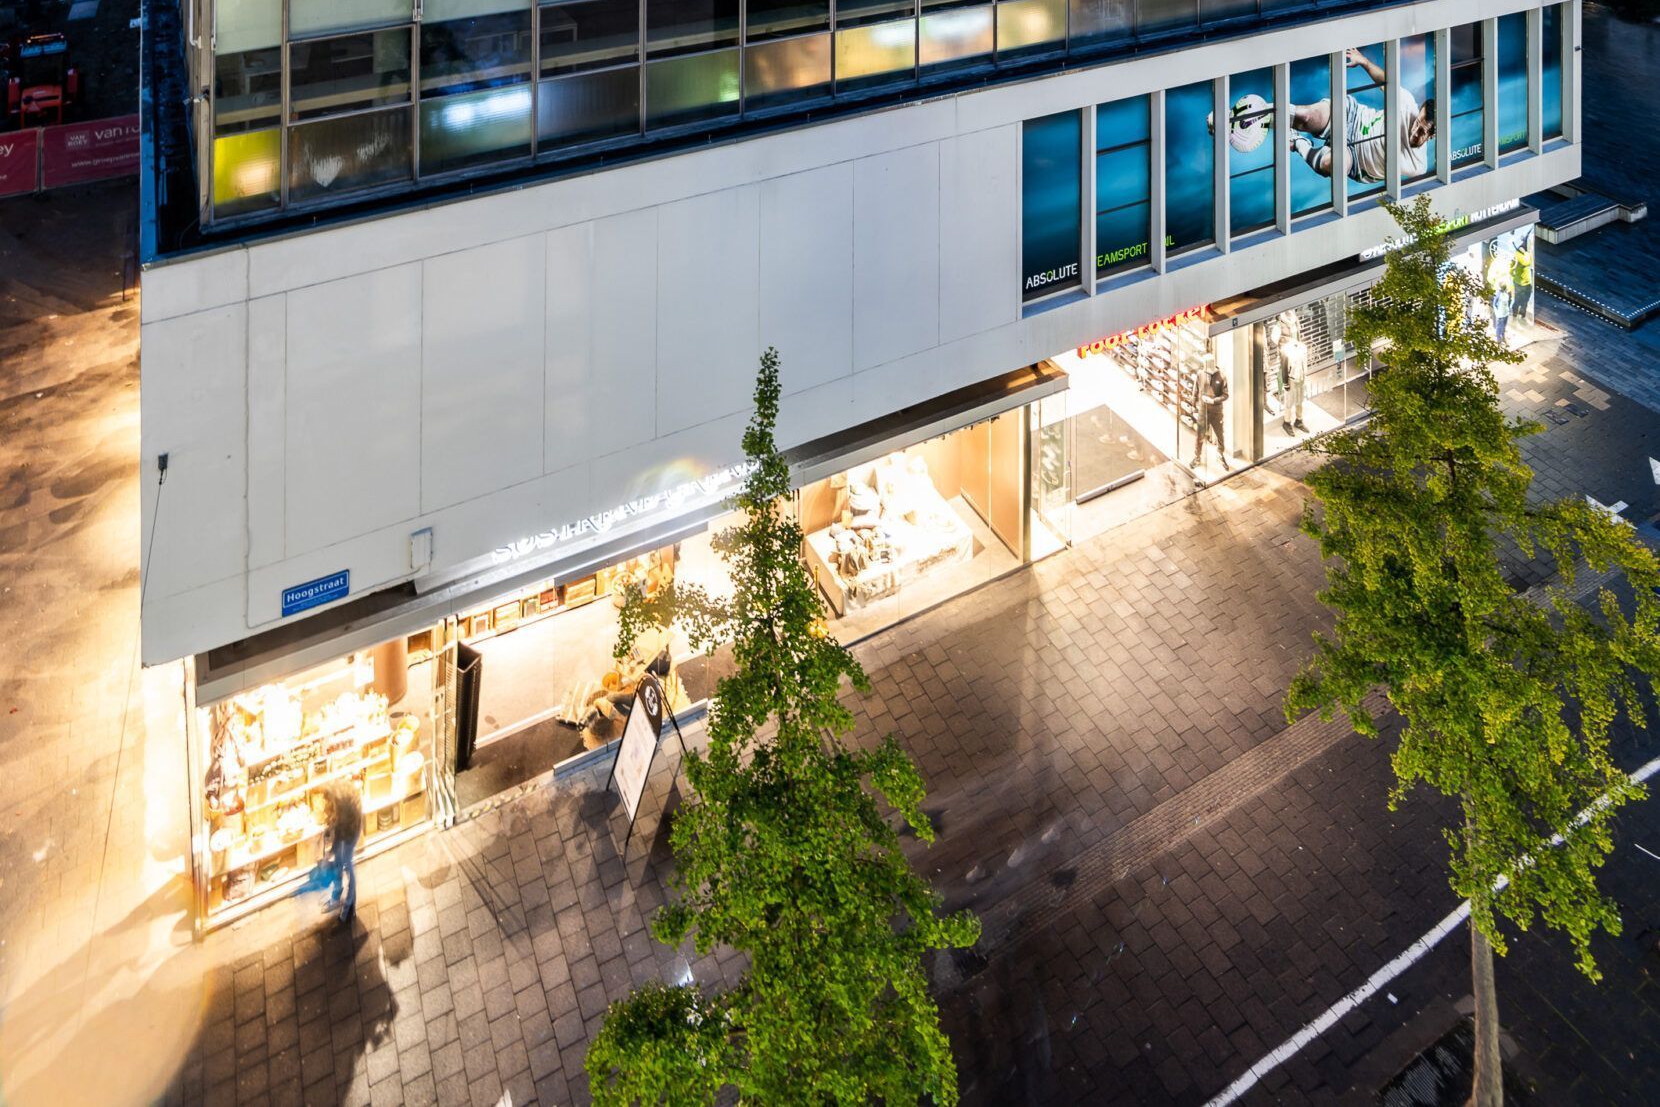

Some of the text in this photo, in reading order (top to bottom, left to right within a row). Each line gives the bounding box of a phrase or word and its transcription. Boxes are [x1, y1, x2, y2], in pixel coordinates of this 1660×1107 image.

[1026, 263, 1078, 289] ABSOLUTE
[1096, 242, 1148, 267] EAMSPORT
[287, 577, 344, 603] Hoogstraat
